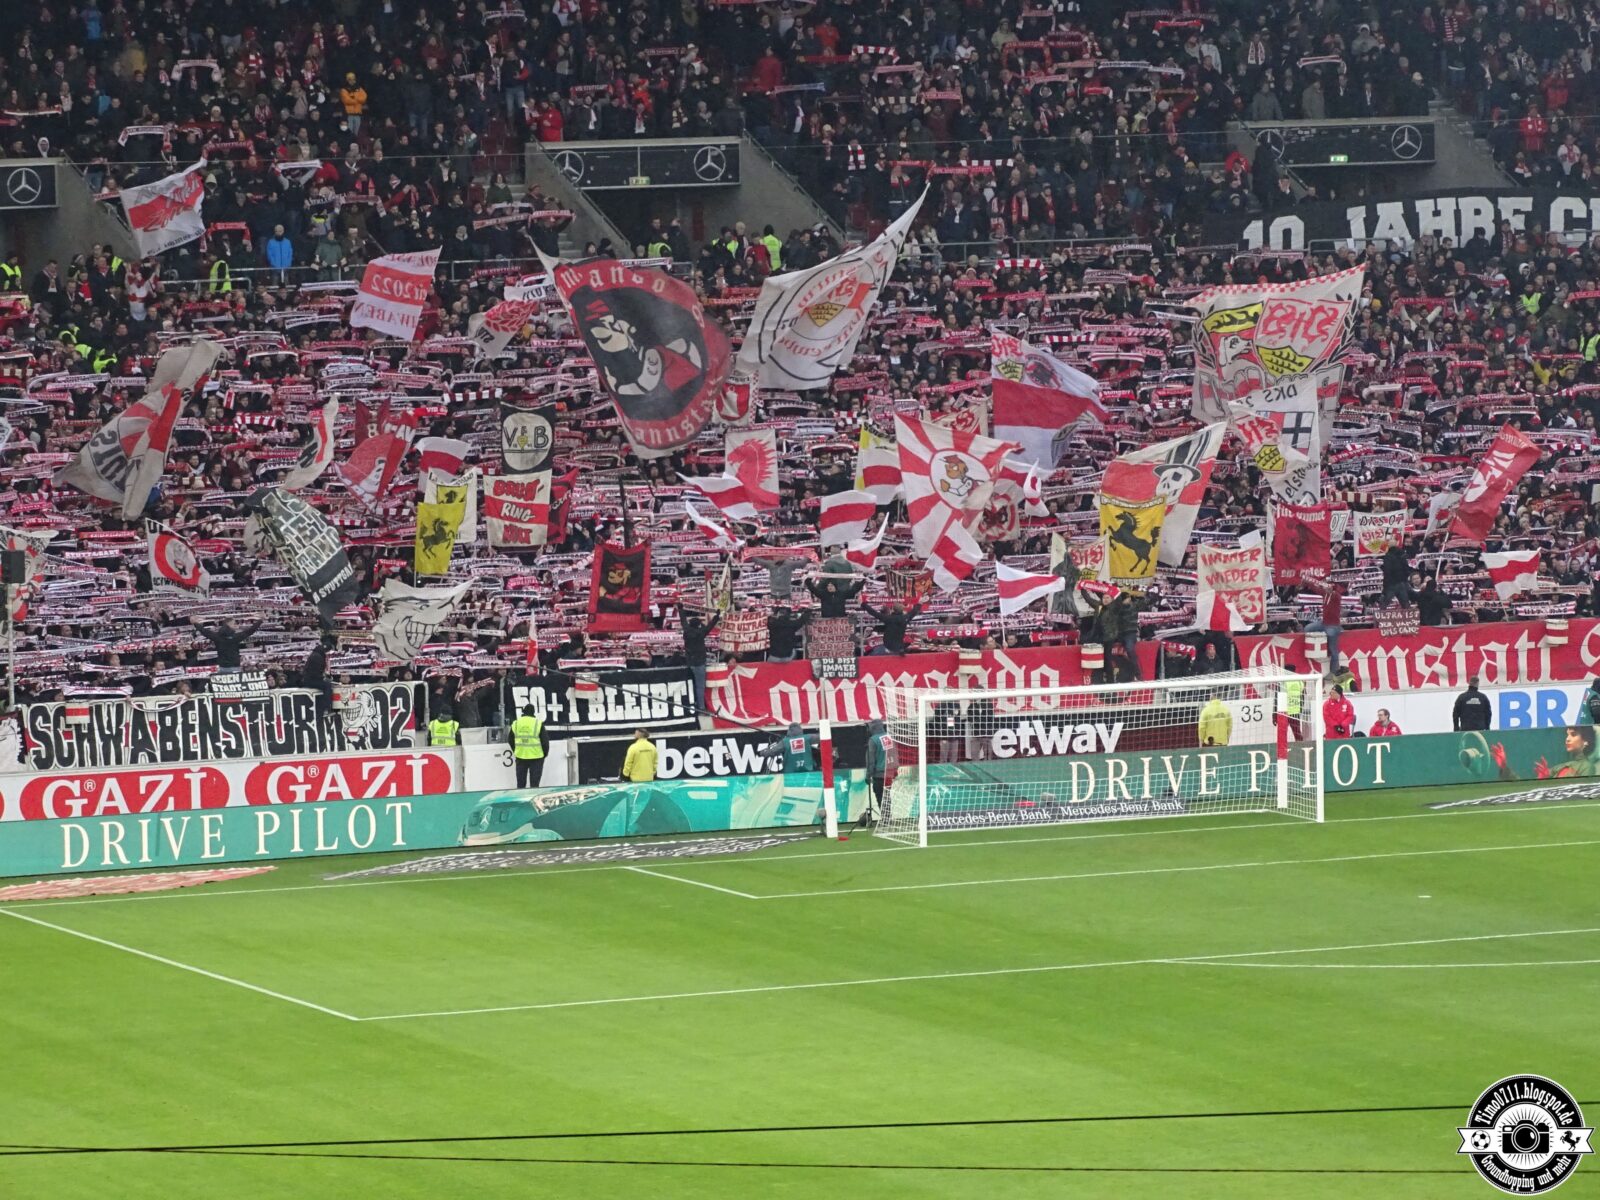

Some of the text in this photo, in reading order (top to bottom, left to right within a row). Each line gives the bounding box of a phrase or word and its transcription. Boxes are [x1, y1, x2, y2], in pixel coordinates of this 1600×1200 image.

[1243, 215, 1305, 251] 10
[1201, 547, 1262, 567] IMMER
[1205, 568, 1259, 587] WIEDER
[822, 664, 857, 672] IMMER
[837, 657, 856, 665] BIST
[368, 684, 415, 750] 02
[1240, 705, 1264, 723] 35
[1068, 741, 1392, 803] DRIVE PLOT
[1059, 799, 1184, 818] Mercedes-Benz Bank
[927, 809, 1051, 828] Mercedes-Benz Bank
[60, 801, 413, 869] DRIVE PILOT
